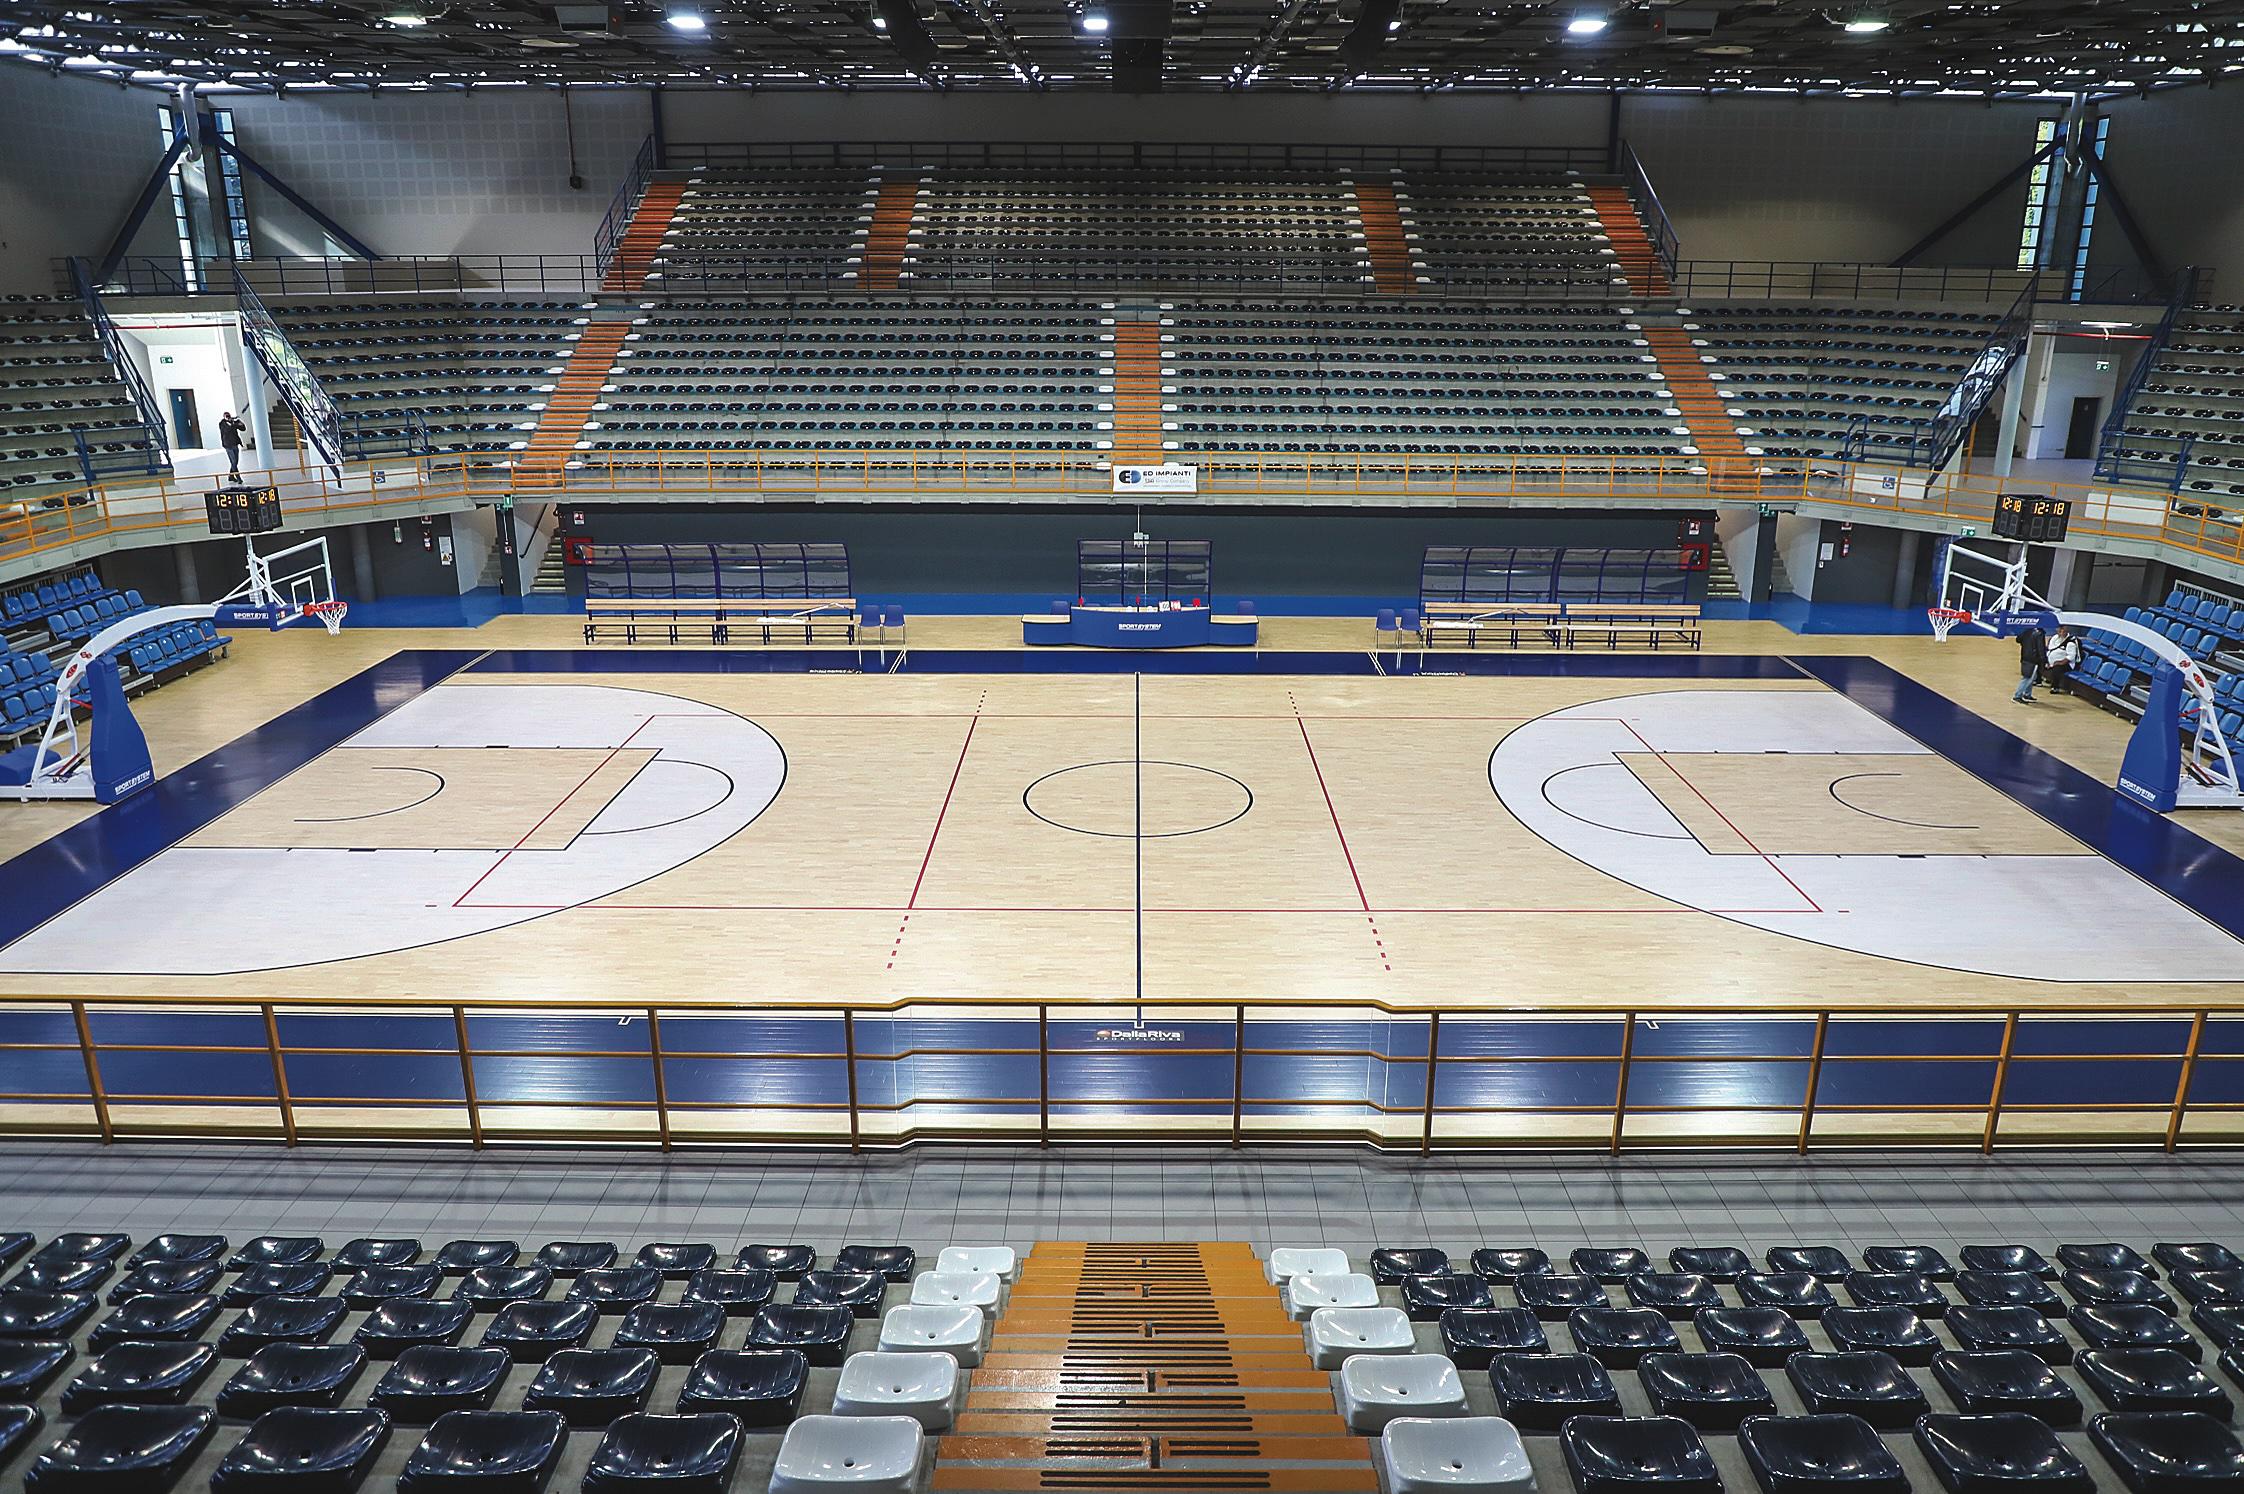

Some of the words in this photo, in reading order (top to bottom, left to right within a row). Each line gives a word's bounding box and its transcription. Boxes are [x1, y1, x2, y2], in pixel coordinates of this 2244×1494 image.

[215, 494, 248, 507] 12:18
[258, 488, 276, 505] 12:18
[2001, 496, 2022, 513] 12:18
[2033, 502, 2065, 516] 12:18
